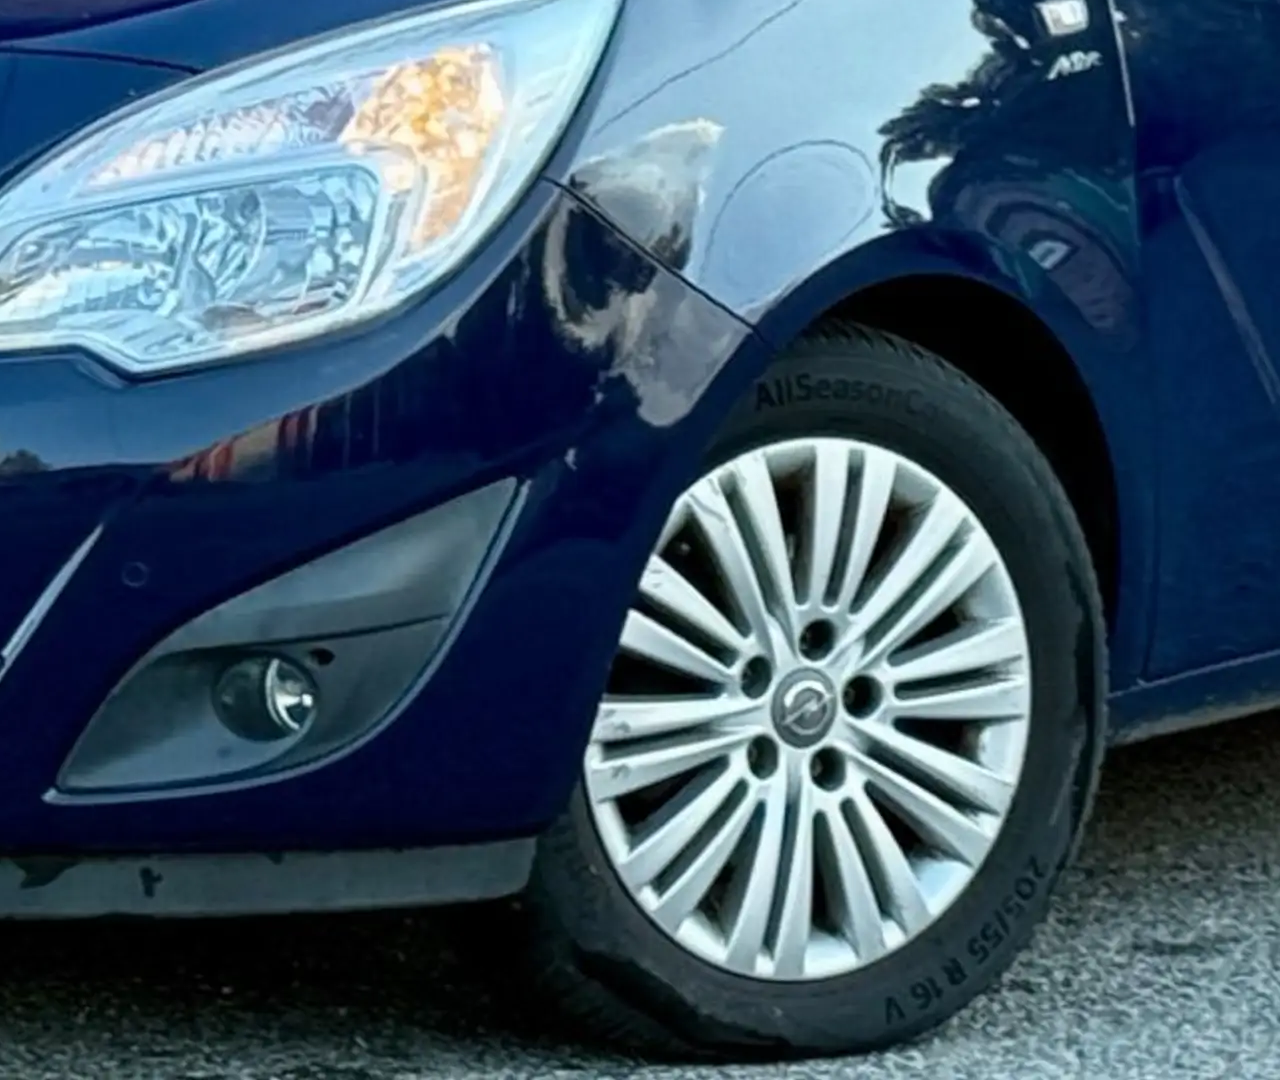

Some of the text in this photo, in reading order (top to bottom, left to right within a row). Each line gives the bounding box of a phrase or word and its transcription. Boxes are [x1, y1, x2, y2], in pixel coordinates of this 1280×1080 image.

[884, 856, 1045, 1024] 205/55 R 16 V
